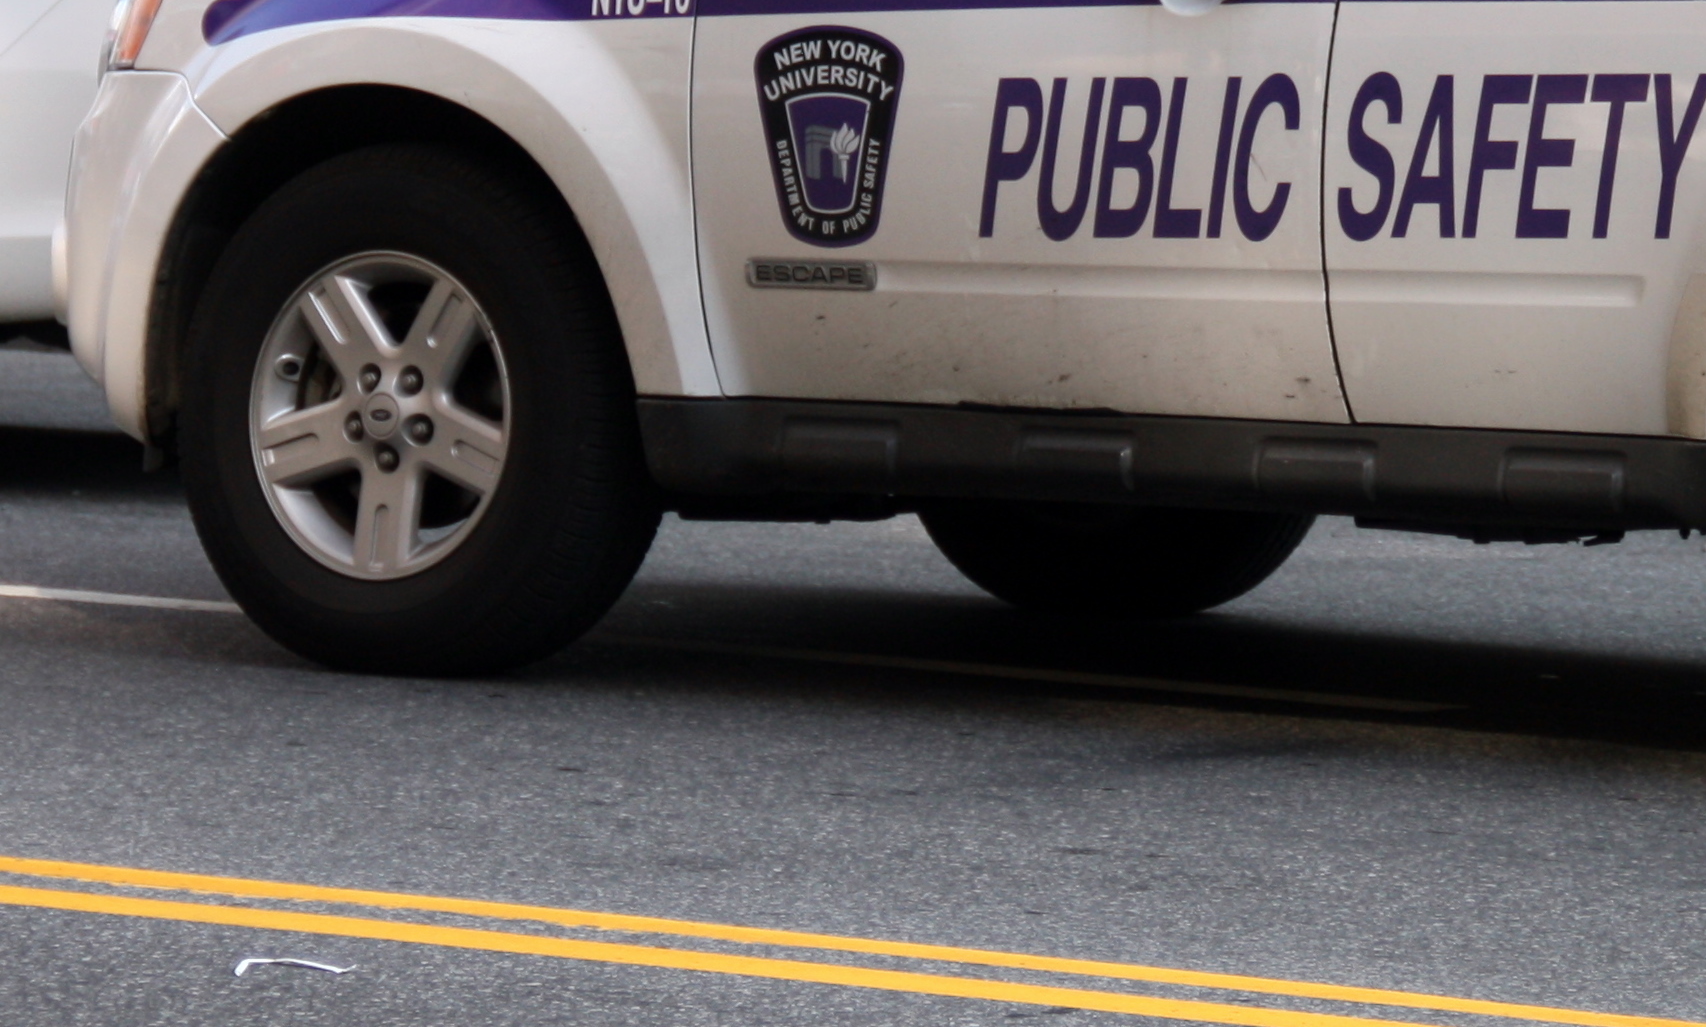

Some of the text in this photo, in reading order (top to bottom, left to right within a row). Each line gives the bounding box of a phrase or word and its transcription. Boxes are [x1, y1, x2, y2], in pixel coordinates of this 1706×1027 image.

[773, 39, 888, 73] NEW YORK
[763, 65, 895, 102] UNIVERSITY
[977, 71, 1301, 243] PUBLIC
[776, 138, 881, 235] DEPARTMENT OF PUBLIC SAFETY
[755, 264, 864, 285] ESCAPE
